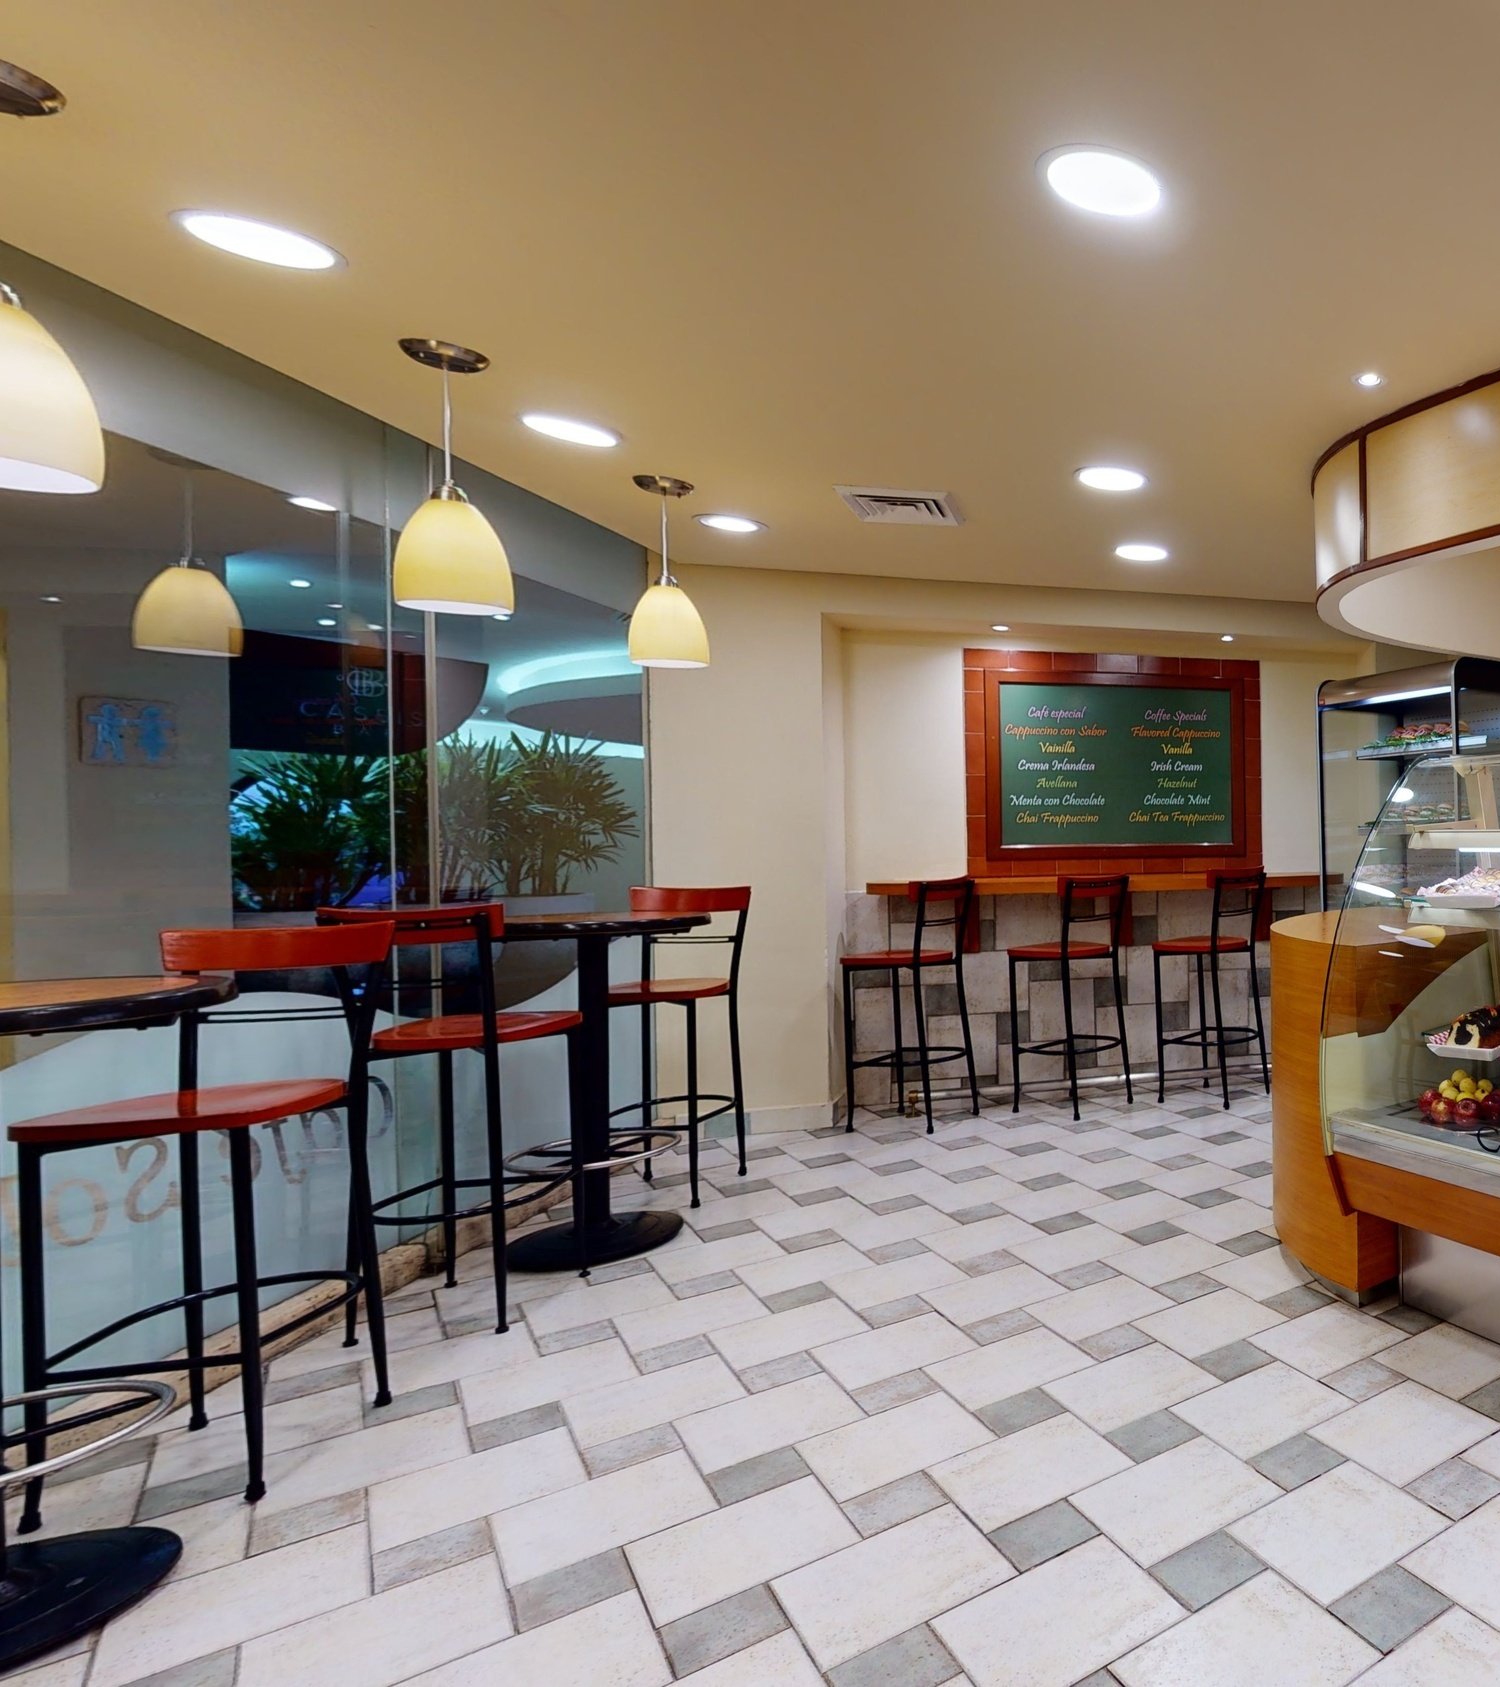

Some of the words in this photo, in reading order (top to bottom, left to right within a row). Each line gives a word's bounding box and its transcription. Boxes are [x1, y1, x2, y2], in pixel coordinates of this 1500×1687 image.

[1027, 705, 1049, 721] Café
[1050, 706, 1087, 723] especial
[1144, 708, 1171, 723] Coffee
[1172, 709, 1208, 726] Specials
[1004, 723, 1059, 740] Cappuccino
[1060, 727, 1076, 736] con
[1078, 723, 1108, 737] Sabor
[1130, 725, 1173, 738] Flavored
[1172, 727, 1221, 742] Cappuccino
[1038, 740, 1076, 754] Vainilla
[1161, 742, 1193, 755] Vanilla
[1017, 758, 1050, 771] Crema
[1051, 757, 1096, 771] Irlandesa
[1150, 758, 1172, 772] Irish
[1173, 760, 1203, 772] Cream
[1036, 775, 1078, 789] Avellana
[1157, 775, 1198, 789] Hazelnut
[1009, 794, 1042, 806] Menta
[1043, 797, 1060, 806] con
[1061, 792, 1106, 806] Chocolate
[1143, 792, 1185, 806] Chocolate
[1187, 793, 1211, 806] Mint
[1016, 810, 1039, 824] Chai
[1041, 811, 1100, 829] Frappuccino
[1128, 809, 1151, 823] Chai
[1152, 811, 1169, 823] Tea
[1171, 811, 1226, 828] Frappuccino
